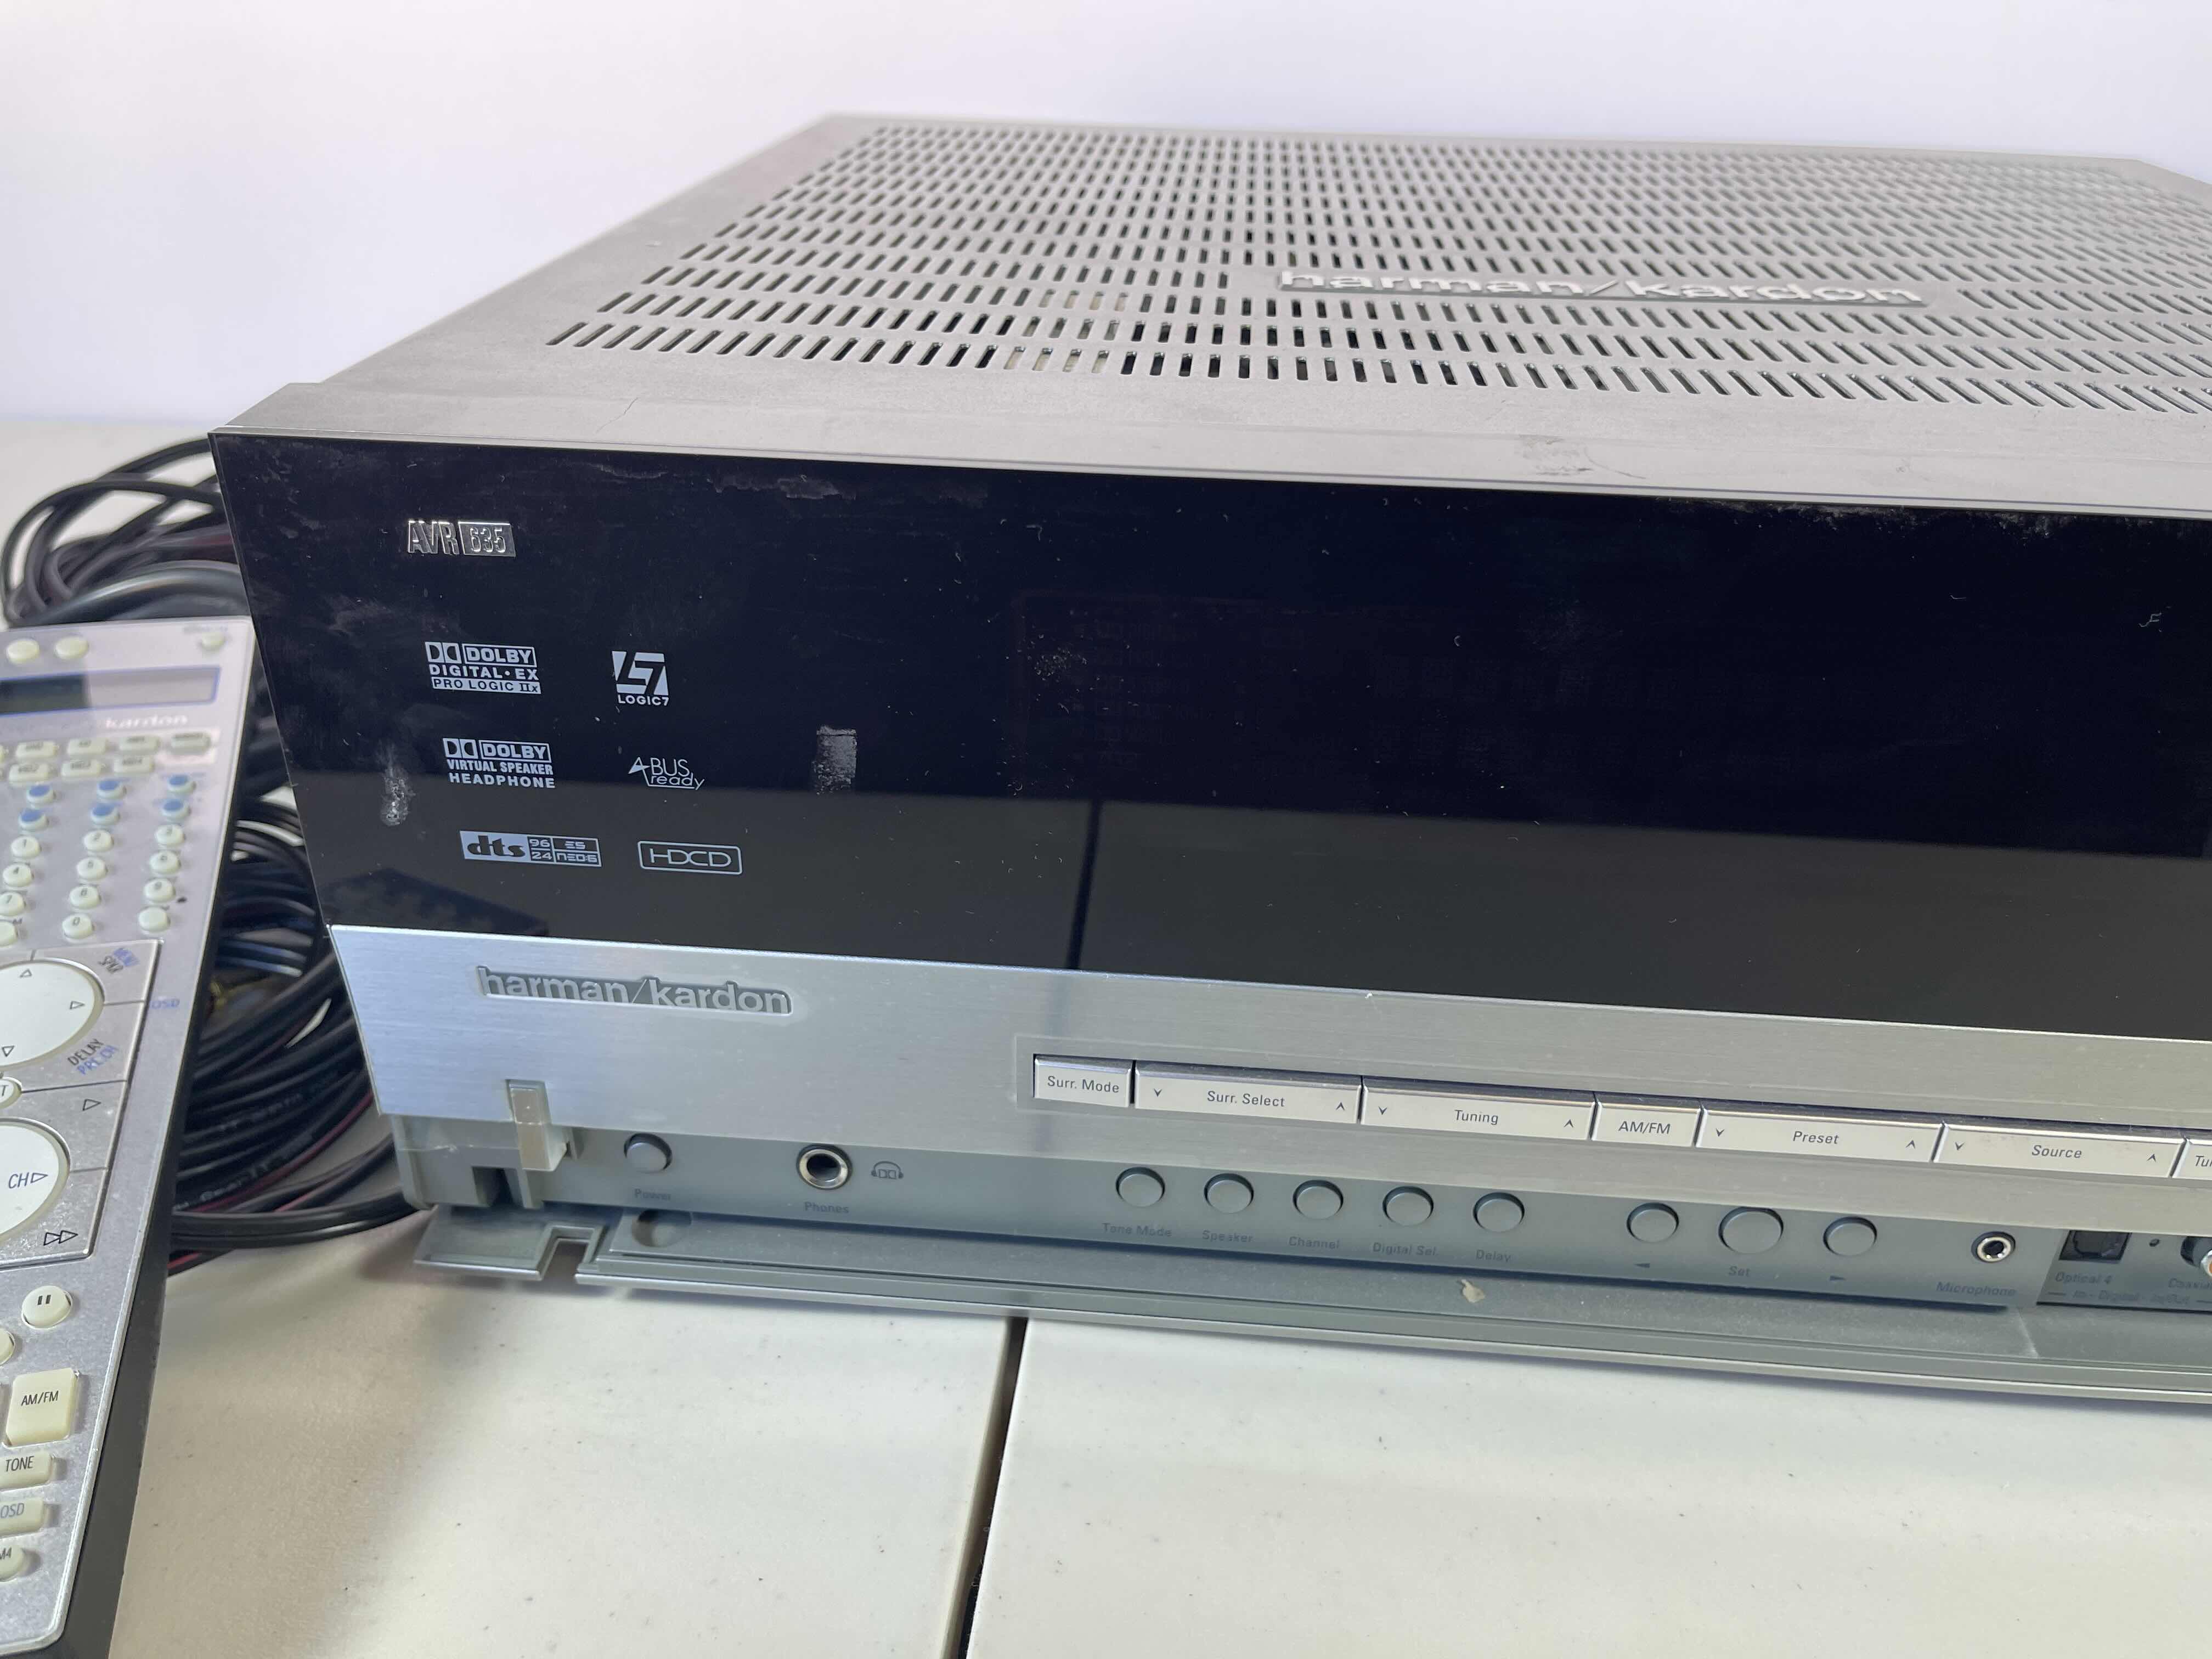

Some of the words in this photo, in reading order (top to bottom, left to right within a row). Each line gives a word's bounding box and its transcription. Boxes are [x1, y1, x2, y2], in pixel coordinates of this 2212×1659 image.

[1281, 272, 1922, 302] harman/kardon
[408, 520, 460, 555] AVR
[470, 526, 506, 553] 635
[466, 647, 532, 664] DOLBY
[433, 678, 463, 689] PRO
[469, 680, 514, 691] LOGIC
[617, 695, 669, 706] LOGIC7
[482, 743, 546, 760] DOLBY
[447, 759, 497, 772] VIRTUAL
[500, 761, 554, 775] SPEAKER
[650, 757, 690, 777] BUS
[449, 772, 556, 789] HEADPHONE
[651, 772, 705, 790] ready
[467, 835, 526, 857] dts
[529, 838, 551, 848] 96
[565, 840, 586, 850] ES
[531, 851, 553, 860] 24
[650, 848, 732, 867] HDCD
[478, 967, 788, 1014] harman/kardon
[67, 1038, 105, 1066] DELAY
[1047, 1075, 1077, 1089] Surr.
[1081, 1077, 1120, 1093] Mode
[1206, 1090, 1238, 1104] Surr.
[1242, 1093, 1285, 1108] Select
[1453, 1109, 1499, 1126] Tuning
[1617, 1120, 1671, 1135] AM/FM
[1792, 1130, 1839, 1145] Preset
[2031, 1144, 2083, 1159] Source
[2195, 1155, 2212, 1167] Tu
[8, 1171, 30, 1189] CH
[804, 1201, 849, 1214] Phones
[1102, 1222, 1133, 1235] Tone
[1136, 1225, 1172, 1238] Mode
[1202, 1229, 1254, 1243] Speaker
[1288, 1236, 1340, 1250] Channel
[1373, 1242, 1412, 1256] Digital
[1475, 1249, 1512, 1263] Delay
[1936, 1281, 2017, 1297] Microphone
[20, 1390, 59, 1407] AM/FM
[5, 1455, 35, 1472] TONE
[0, 1502, 25, 1519] OSD
